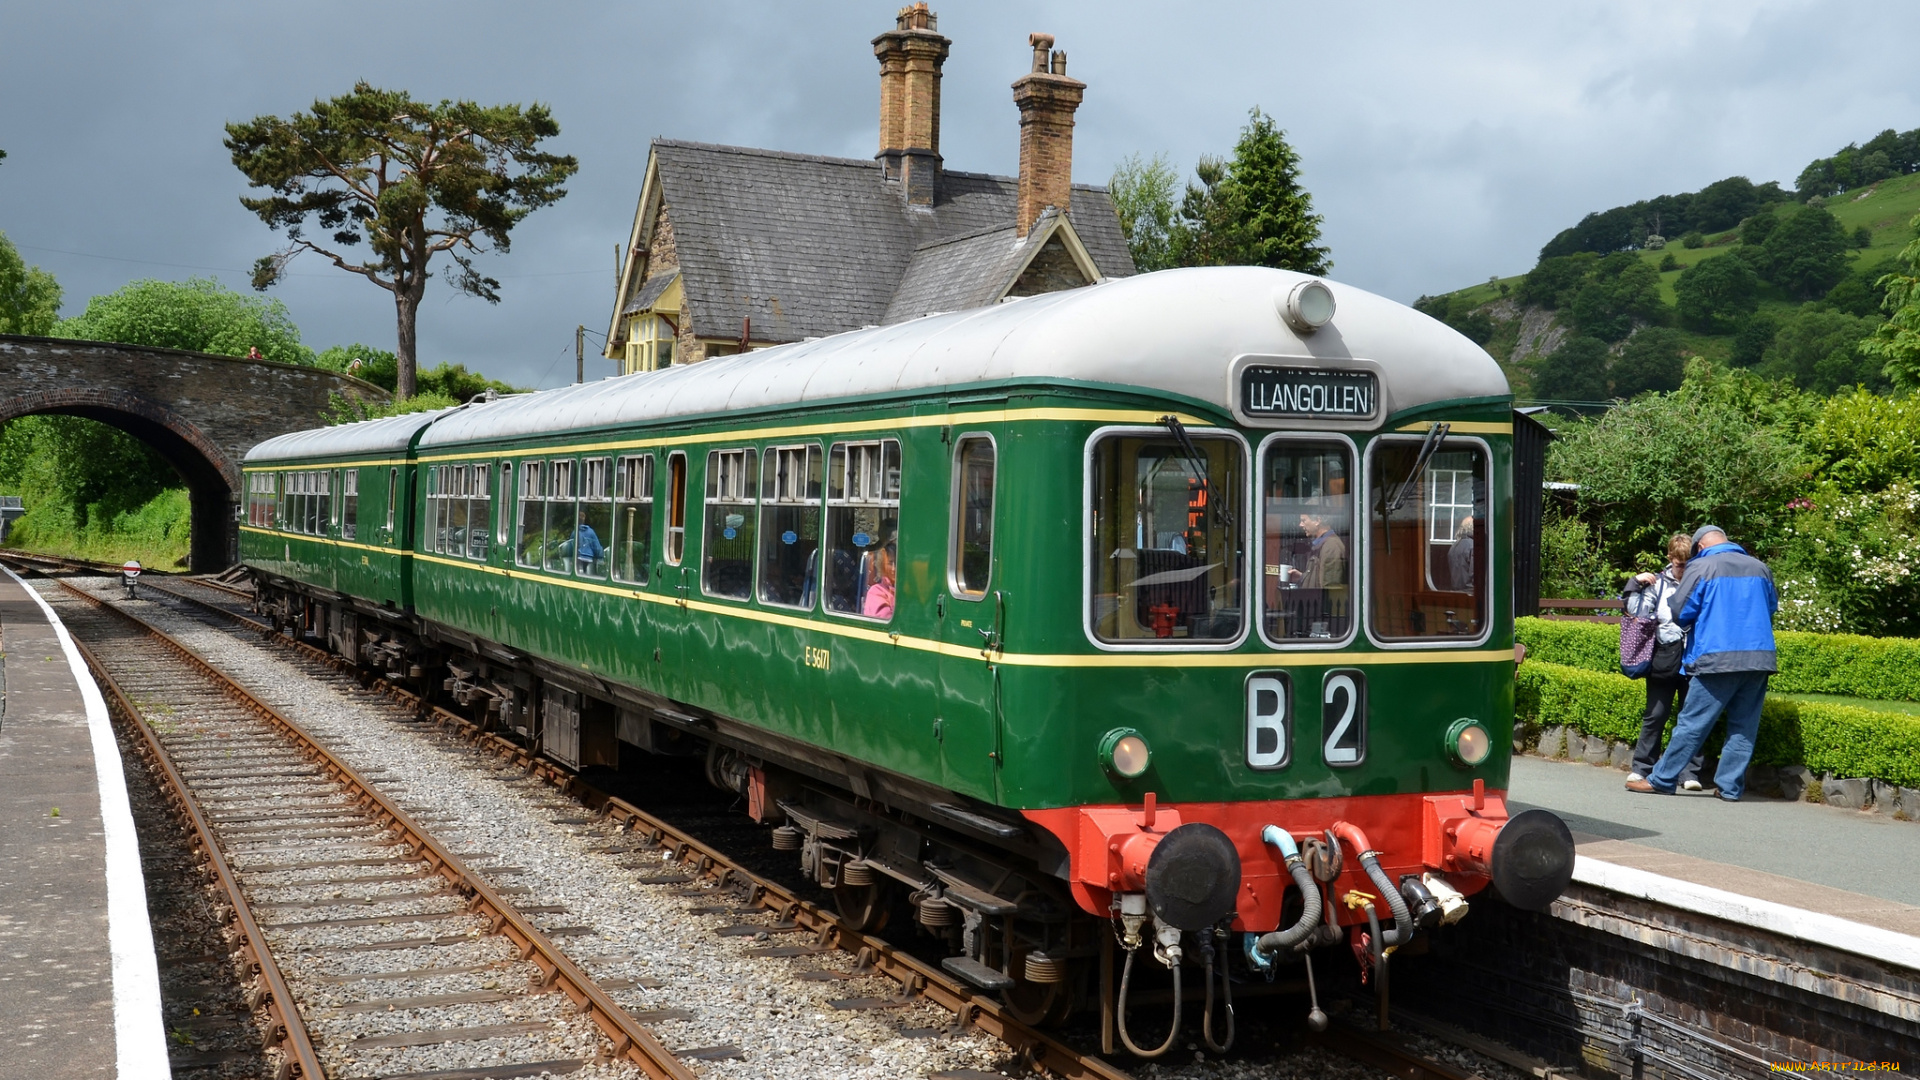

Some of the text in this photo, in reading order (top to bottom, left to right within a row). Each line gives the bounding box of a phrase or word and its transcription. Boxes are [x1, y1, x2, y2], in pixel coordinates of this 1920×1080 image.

[1251, 383, 1368, 413] LLANGOLLEN
[805, 646, 830, 670] E 56171
[1248, 675, 1357, 766] B 2
